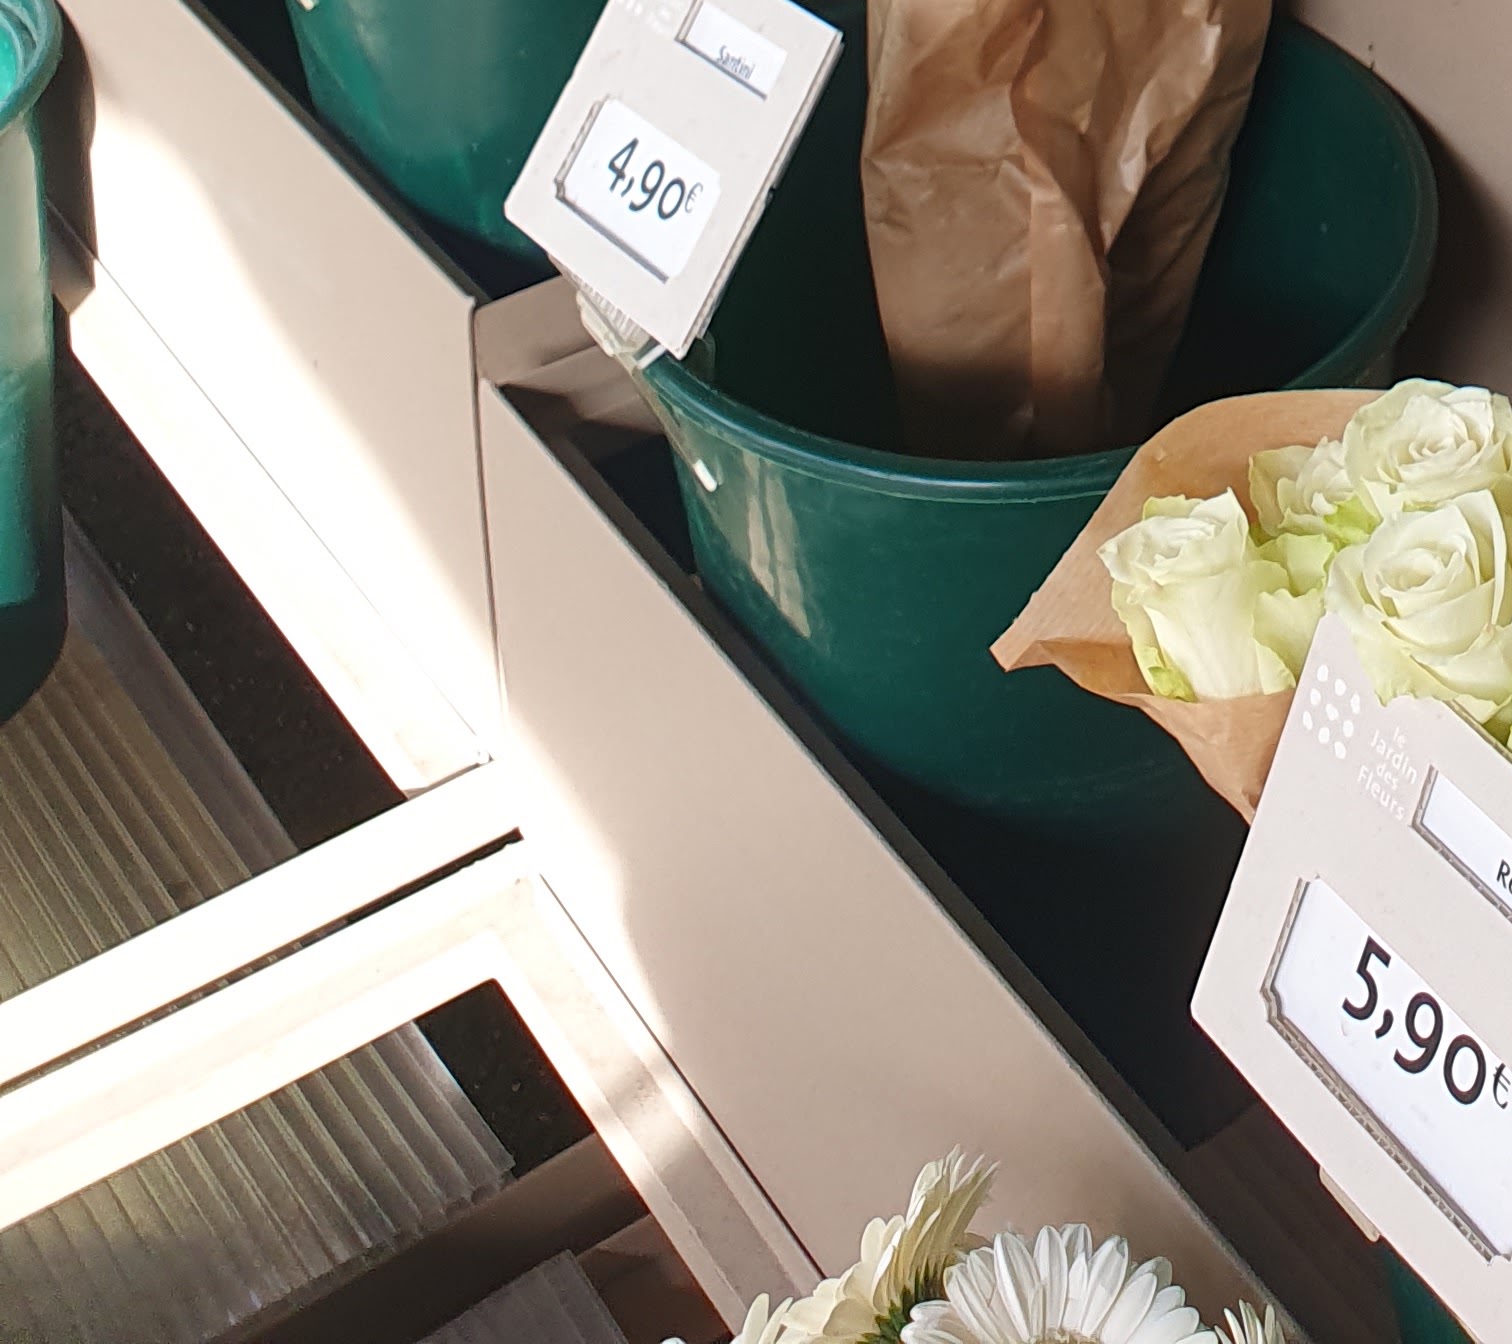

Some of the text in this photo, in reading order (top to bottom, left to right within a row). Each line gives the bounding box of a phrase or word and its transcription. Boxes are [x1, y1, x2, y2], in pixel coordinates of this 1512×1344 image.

[607, 137, 704, 221] 4,90€
[1369, 728, 1418, 785] Jardin
[1356, 764, 1405, 821] Fleurs
